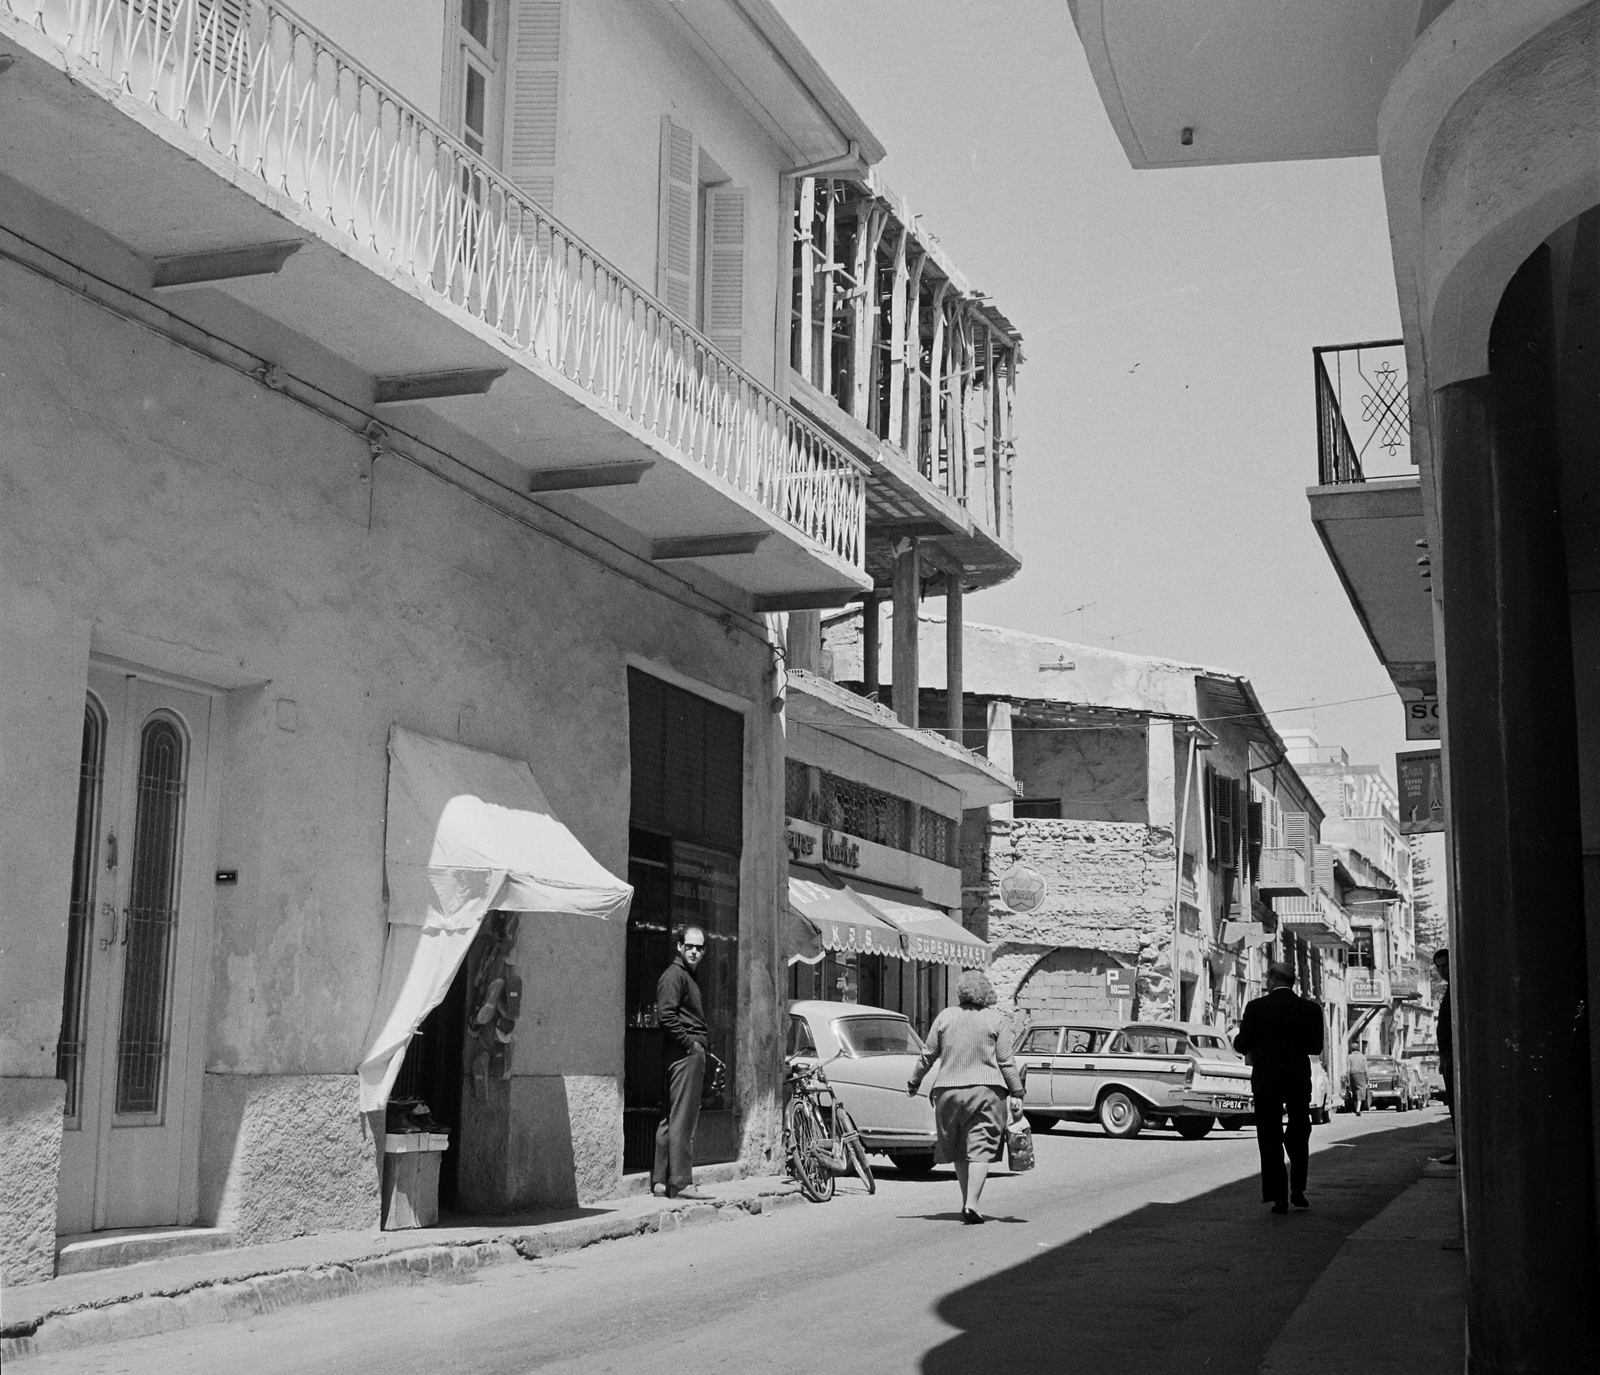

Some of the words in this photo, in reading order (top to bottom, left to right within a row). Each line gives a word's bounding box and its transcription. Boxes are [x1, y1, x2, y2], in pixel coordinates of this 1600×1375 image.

[916, 937, 986, 962] SUPERMARKET
[1107, 969, 1119, 985] P
[1110, 984, 1118, 994] 10
